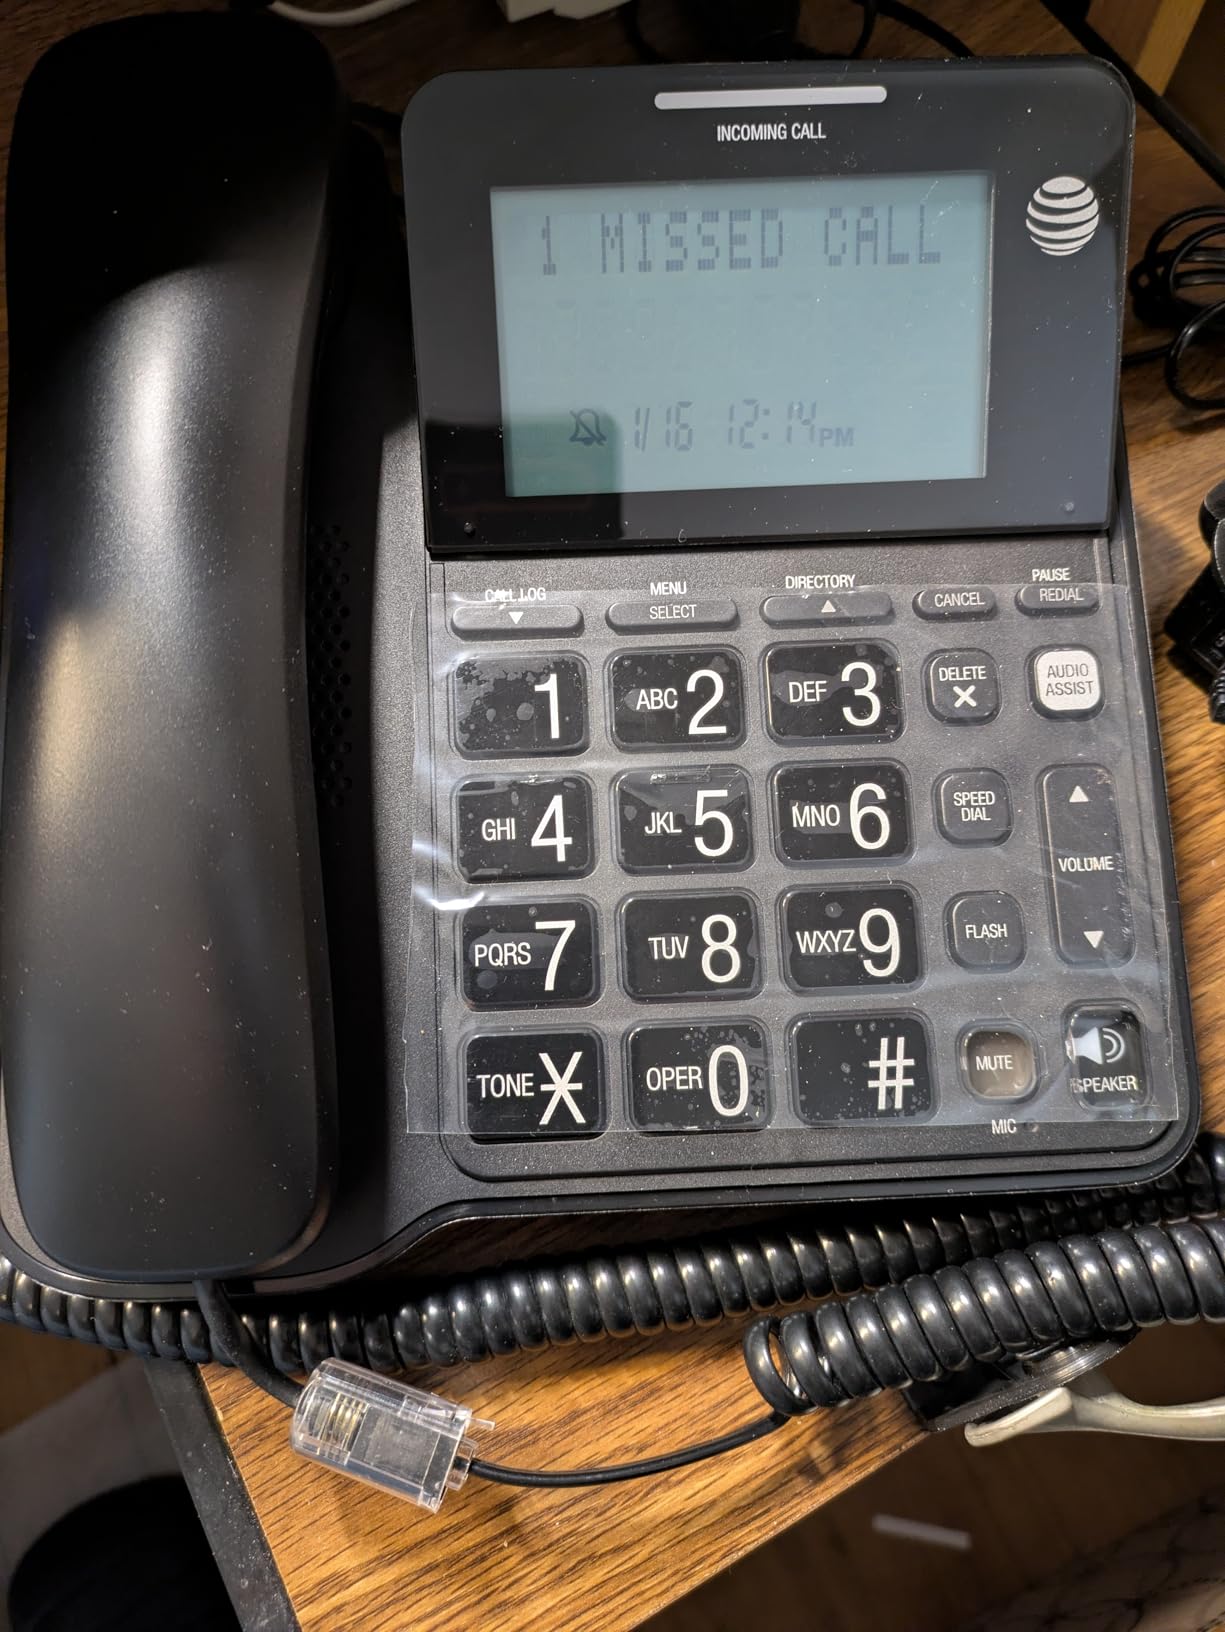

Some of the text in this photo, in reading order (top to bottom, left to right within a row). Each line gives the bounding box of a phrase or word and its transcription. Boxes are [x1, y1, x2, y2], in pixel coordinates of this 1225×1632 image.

[716, 122, 827, 142] INCOMING CALL
[541, 204, 941, 276] 1 MISSED CALL
[819, 427, 855, 448] PM
[785, 574, 856, 590] DIRECTORY
[1032, 568, 1071, 582] PAUSE
[518, 587, 547, 601] LOG
[650, 581, 687, 596] MENU
[1039, 587, 1084, 602] REDIAL
[934, 592, 985, 608] CANCEL
[649, 604, 697, 620] SELECT
[939, 666, 987, 682] DELETE
[1047, 663, 1089, 679] AUDIO
[788, 661, 882, 727] DEF 3
[1046, 680, 1095, 697] ASSIST
[534, 673, 560, 739] 1
[636, 669, 727, 736] ABC 2
[953, 790, 995, 807] SPEED
[644, 789, 734, 857] JKL 5
[791, 782, 891, 851] MNO 6
[961, 807, 991, 822] DIAL
[481, 794, 573, 863] GHI 4
[1058, 855, 1115, 873] VOLUME
[965, 923, 1008, 939] FLASH
[648, 914, 742, 984] TUV 8
[796, 908, 902, 978] WXYZ 9
[474, 920, 576, 991] PQRS 7
[975, 1055, 1014, 1071] MUTE
[645, 1045, 750, 1118] OPER 0
[867, 1036, 915, 1111] #
[476, 1072, 535, 1099] TONE
[1072, 1075, 1138, 1093] SPEAKER
[991, 1119, 1018, 1135] MIC
